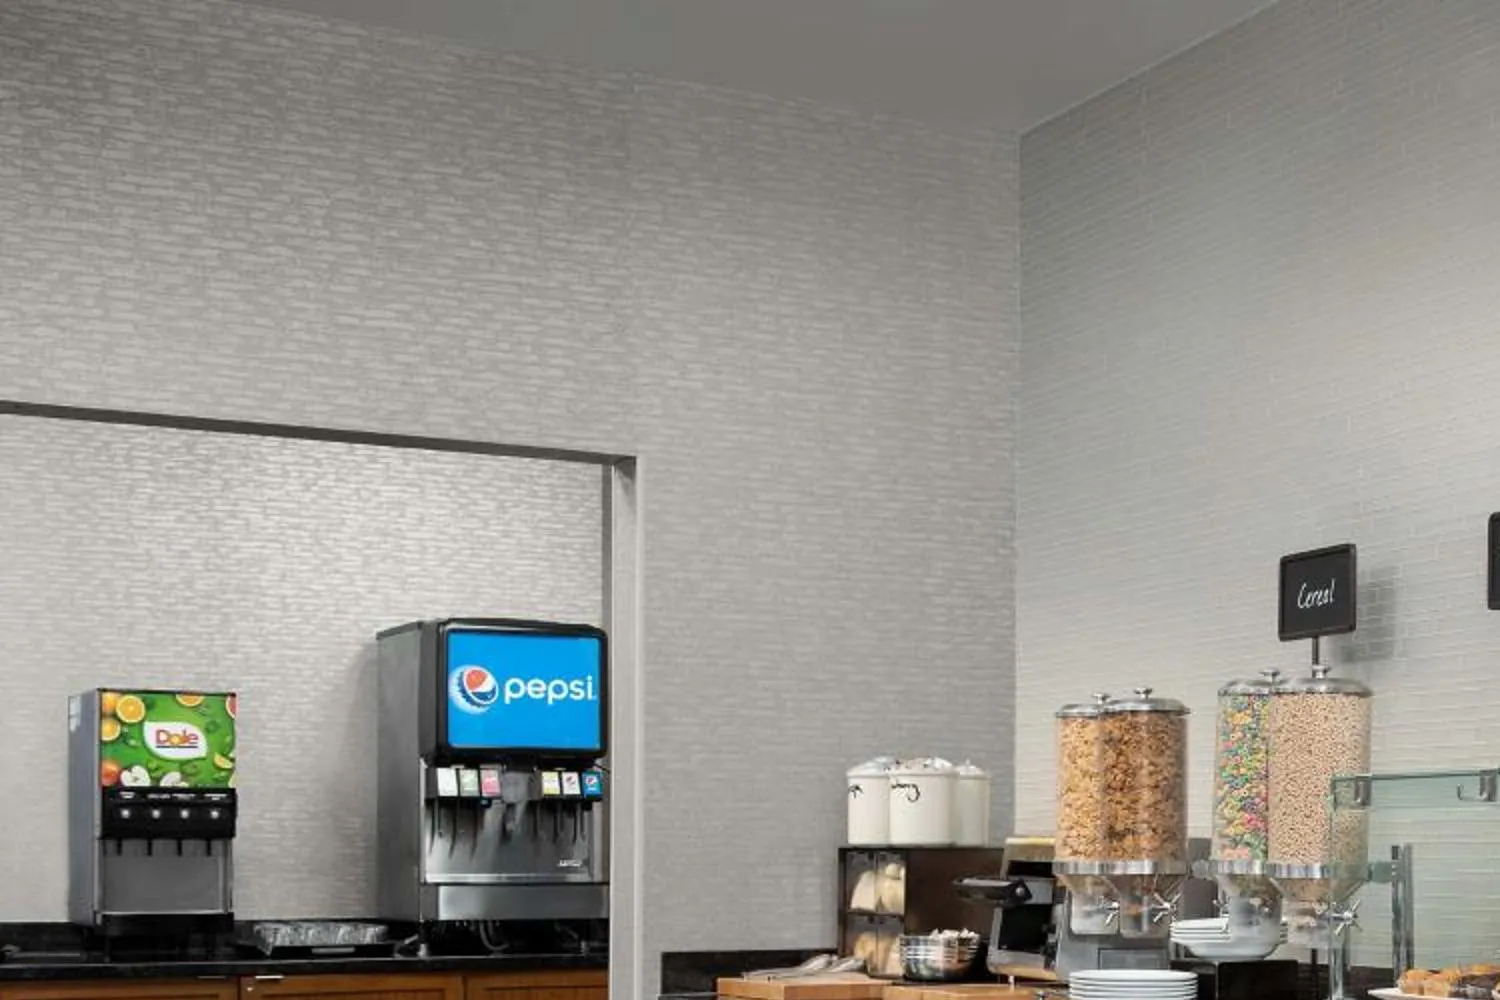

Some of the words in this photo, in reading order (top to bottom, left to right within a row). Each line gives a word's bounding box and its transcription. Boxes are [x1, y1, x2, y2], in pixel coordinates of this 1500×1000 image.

[1297, 578, 1335, 609] Cereal
[503, 674, 595, 705] pepsi
[155, 729, 199, 746] Dole
